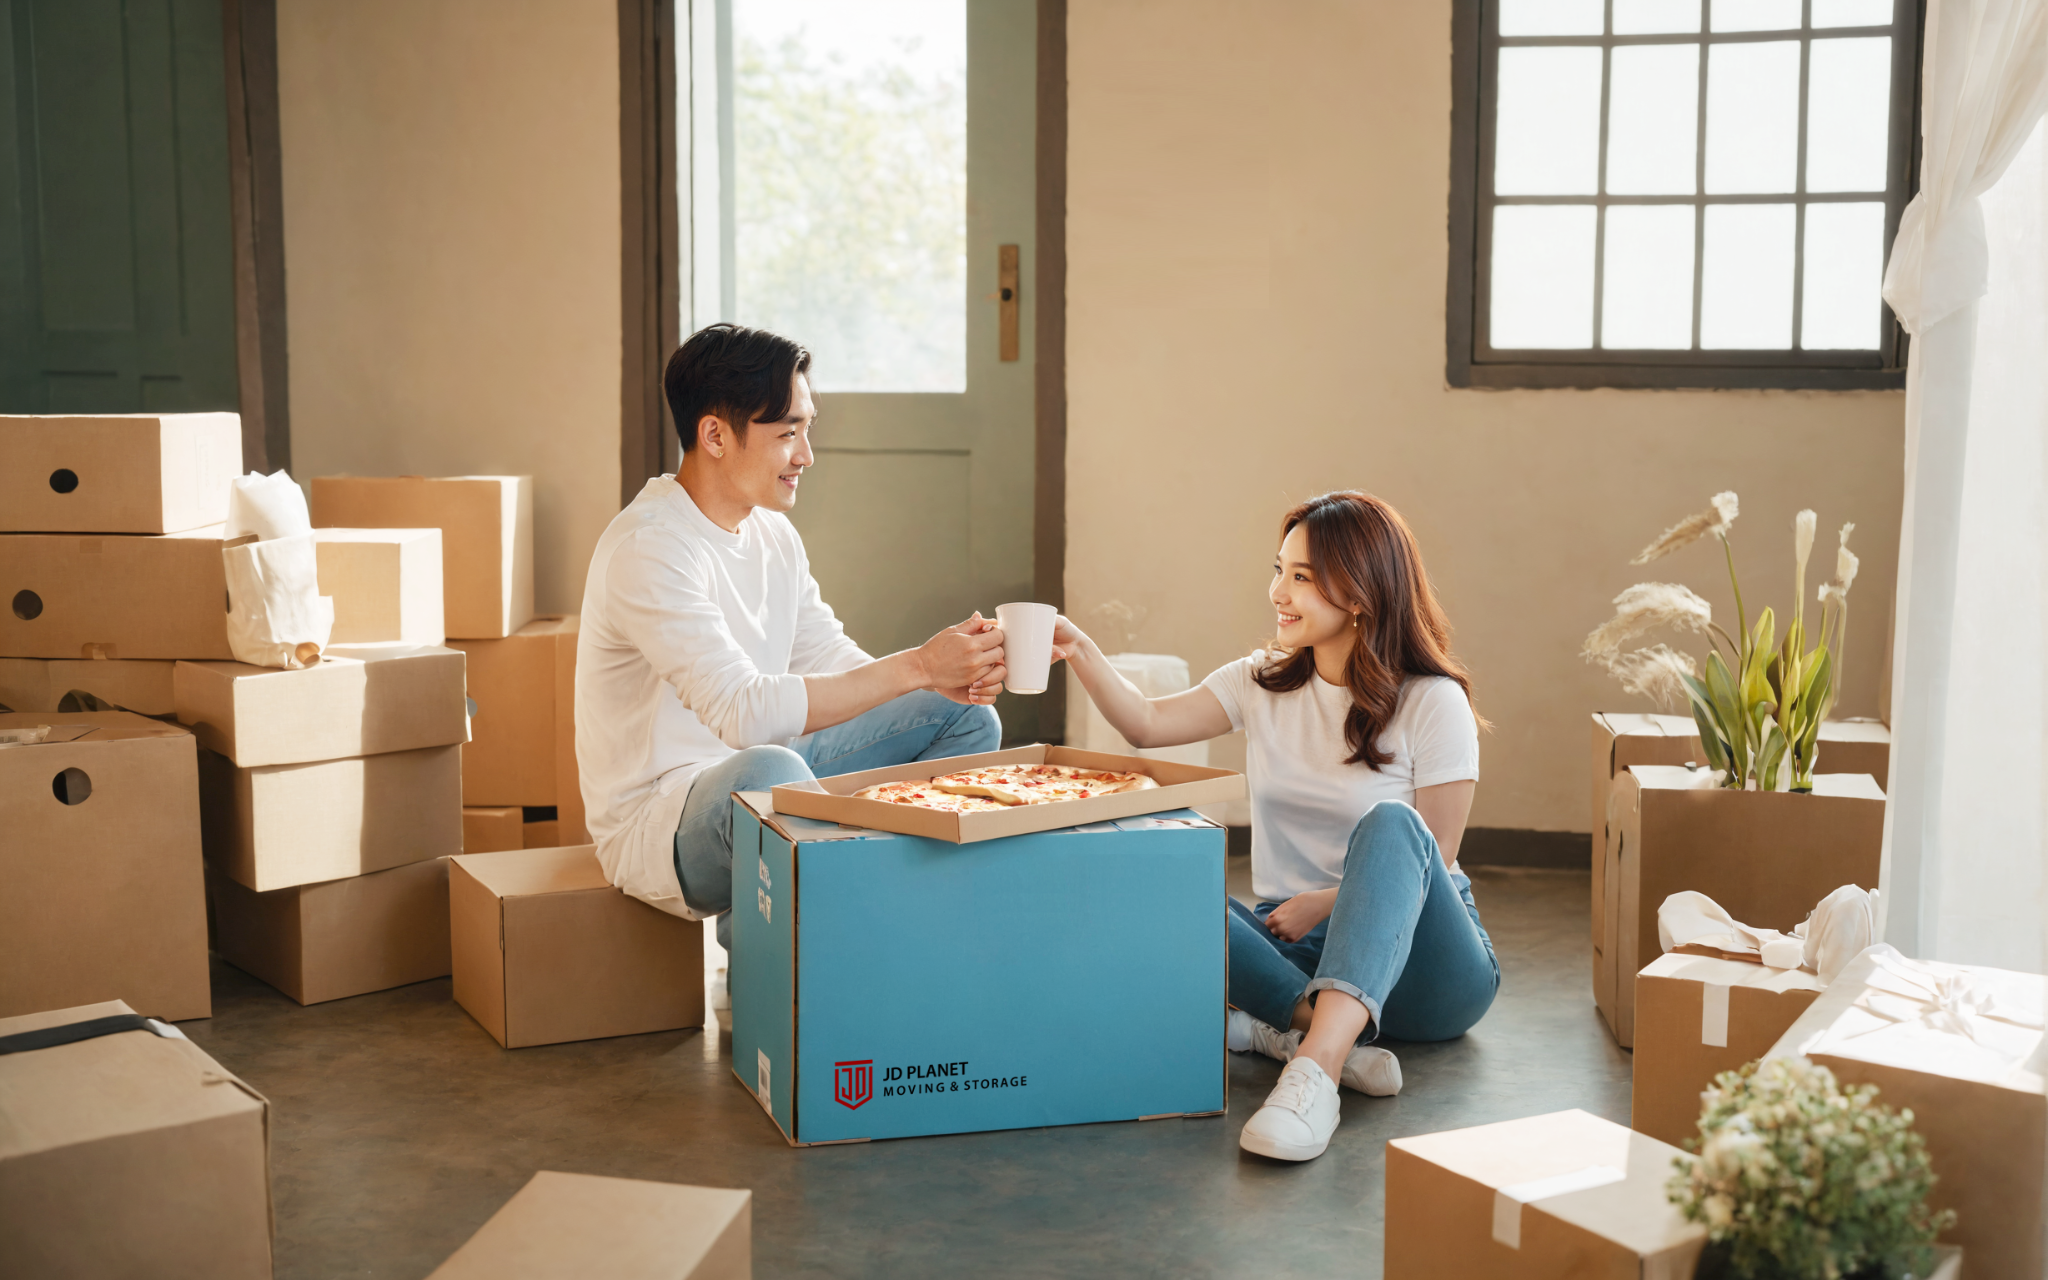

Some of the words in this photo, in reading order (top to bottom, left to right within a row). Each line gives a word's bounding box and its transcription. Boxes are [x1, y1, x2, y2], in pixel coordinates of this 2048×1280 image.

[882, 1066, 903, 1082] JD
[906, 1061, 969, 1080] PLANET
[883, 1082, 945, 1097] MOVING
[949, 1081, 959, 1092] &
[963, 1075, 1028, 1091] STORAGE
